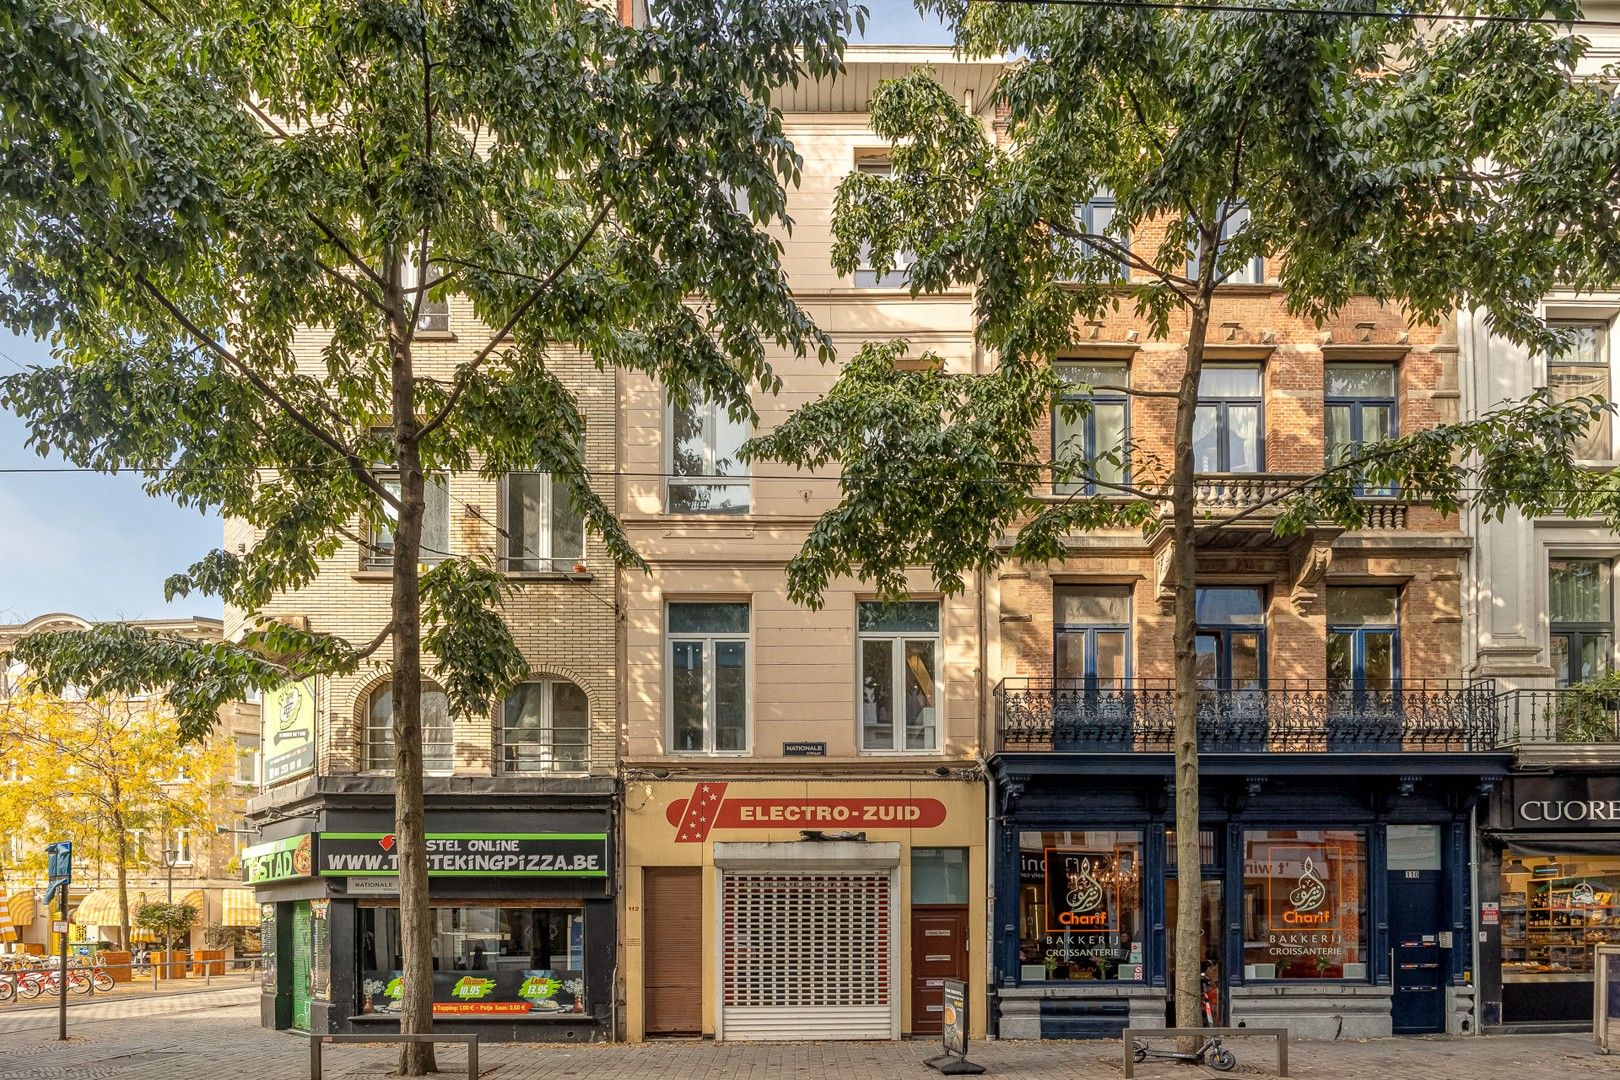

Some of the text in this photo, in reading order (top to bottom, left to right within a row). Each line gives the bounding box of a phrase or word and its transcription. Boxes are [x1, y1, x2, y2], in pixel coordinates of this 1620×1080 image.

[426, 840, 461, 851] STEL
[259, 851, 292, 881] STAD
[1058, 911, 1107, 925] Charif
[1283, 910, 1331, 924] Charif
[1046, 935, 1119, 945] BAKKERIJ
[1269, 934, 1341, 944] BAKKERIJ
[1046, 948, 1119, 957] CROISSANTERIE
[1269, 947, 1341, 956] CROISSANTERIE
